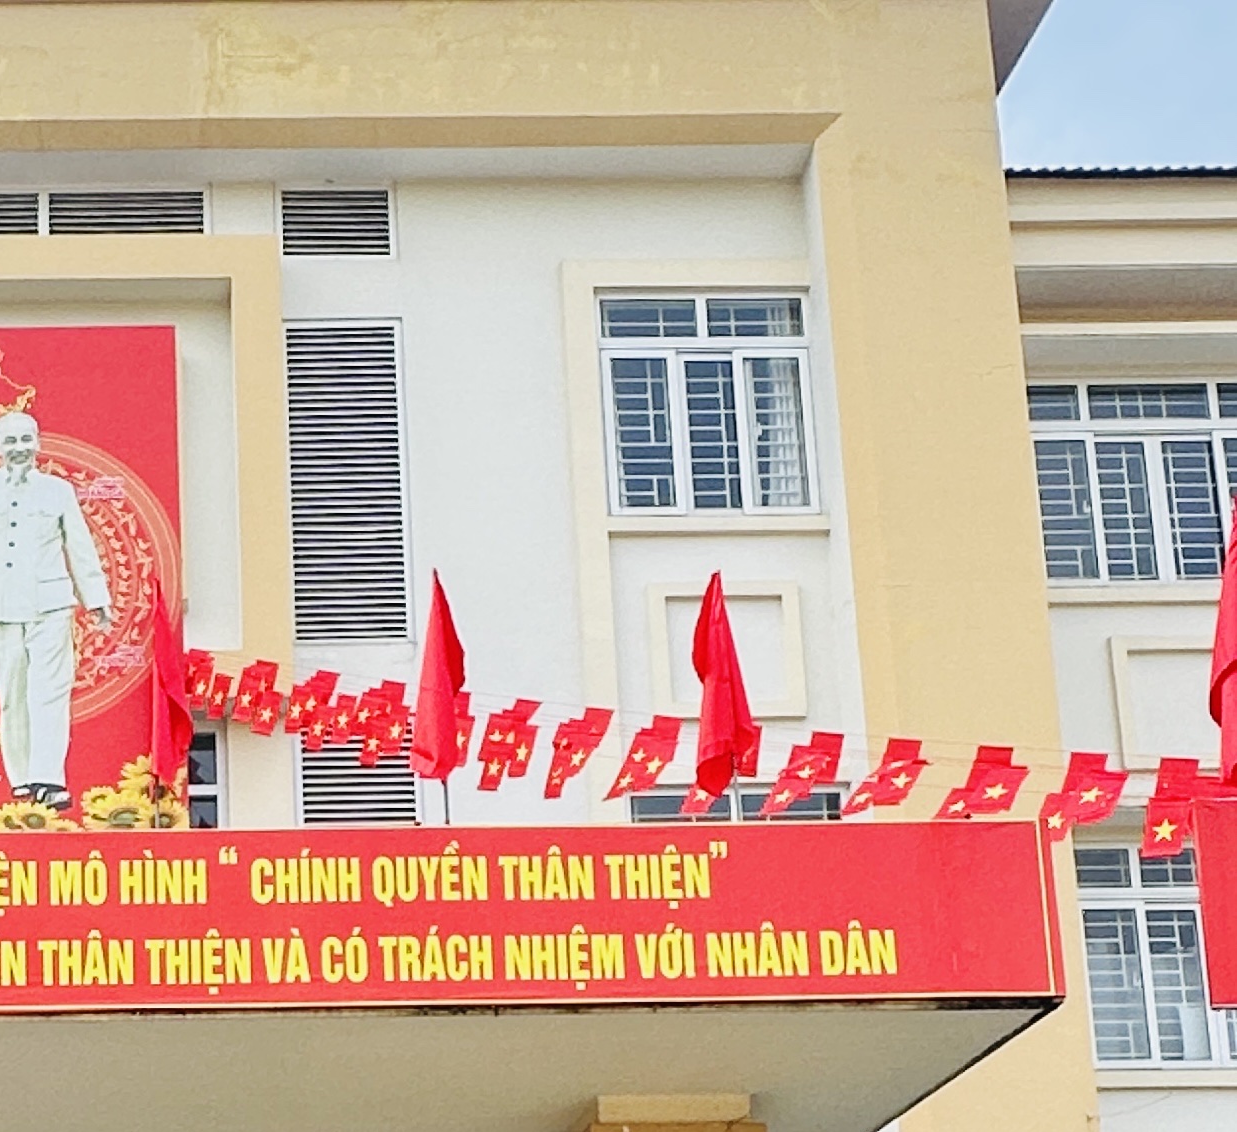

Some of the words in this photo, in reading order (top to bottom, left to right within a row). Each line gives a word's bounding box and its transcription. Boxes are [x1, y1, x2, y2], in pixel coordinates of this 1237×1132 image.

[49, 850, 107, 905] MÔ
[120, 850, 207, 904] HÌNH
[251, 848, 361, 904] CHÍNH
[372, 842, 488, 907] QUYỀN
[498, 845, 594, 900] THÂN
[604, 842, 727, 909] THIỆN”
[38, 930, 133, 986] THÂN
[145, 929, 251, 994] THIỆN
[262, 928, 311, 983] VÀ
[321, 927, 368, 983] CÓ
[378, 925, 493, 981] TRÁCH
[504, 924, 625, 990] NHIỆM
[635, 923, 696, 979] VỚI
[706, 922, 809, 977] NHÂN
[819, 920, 897, 975] DÂN
